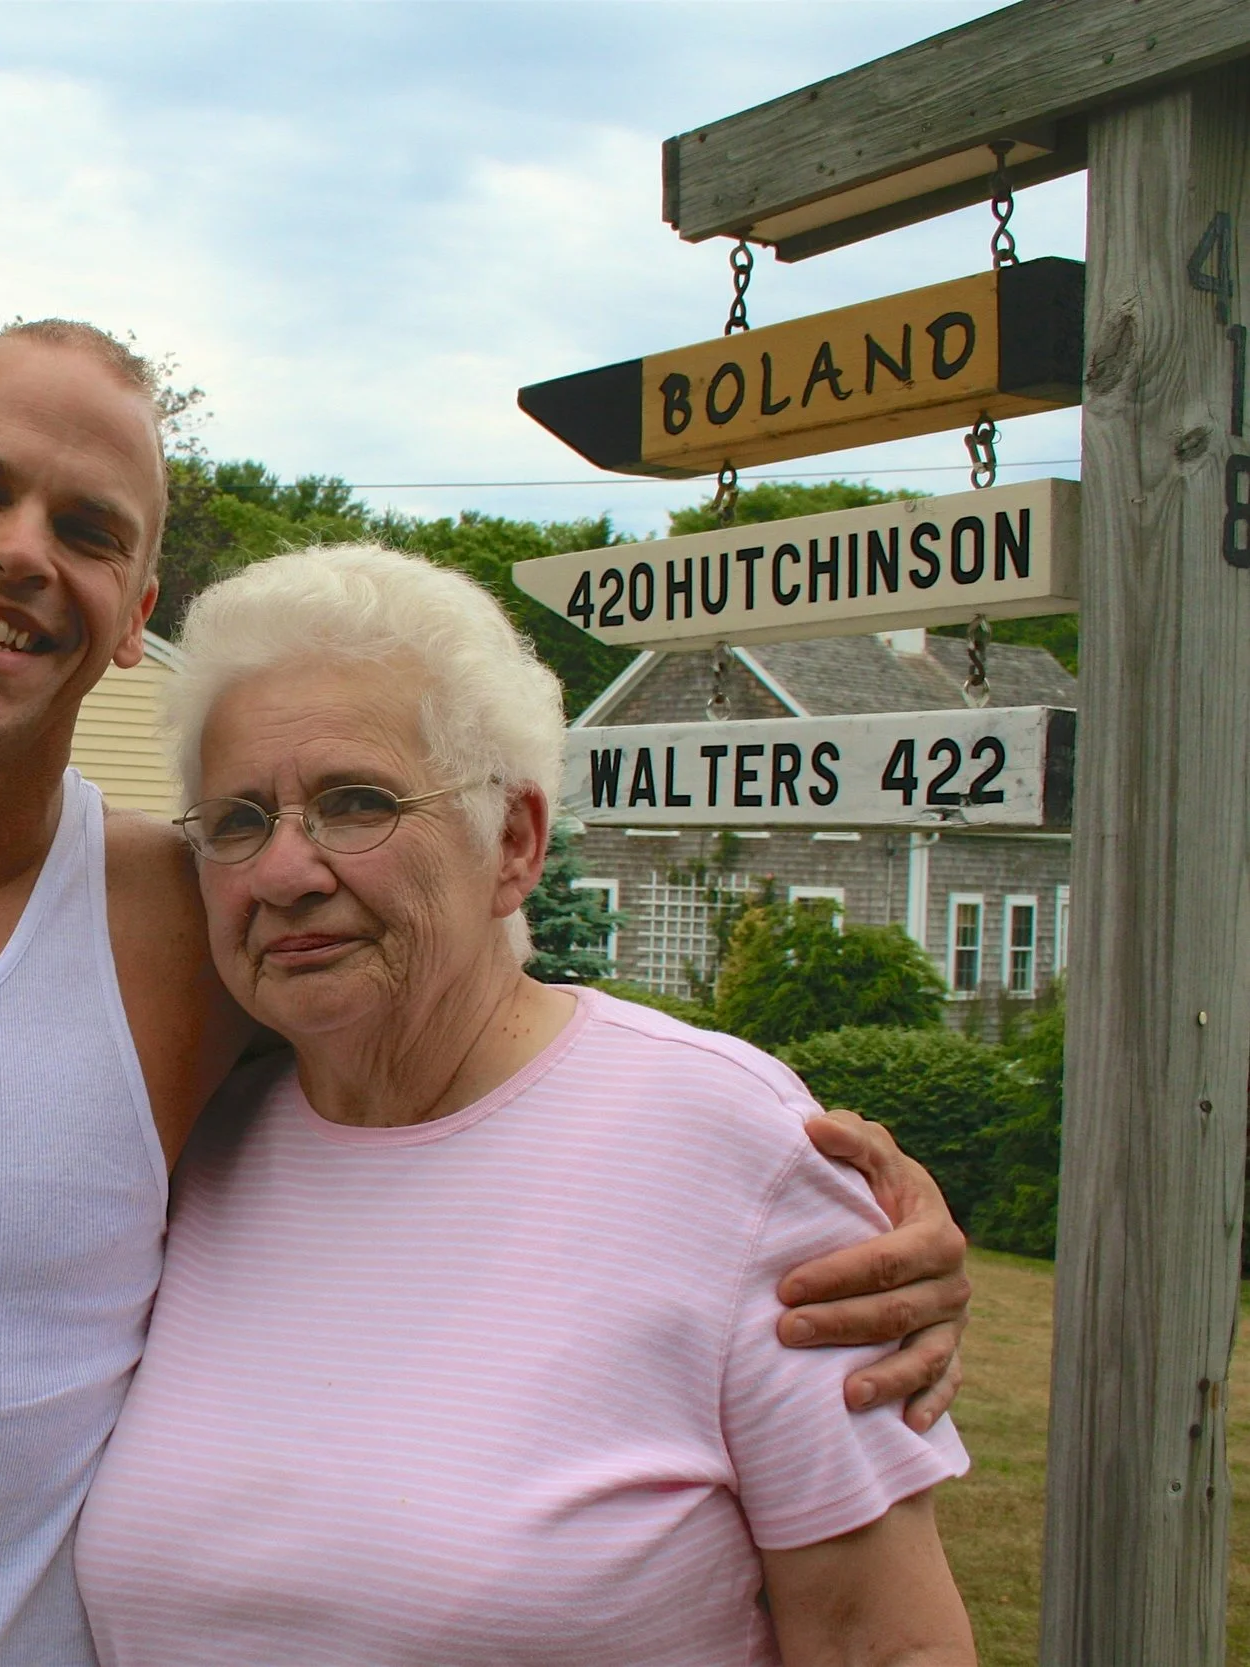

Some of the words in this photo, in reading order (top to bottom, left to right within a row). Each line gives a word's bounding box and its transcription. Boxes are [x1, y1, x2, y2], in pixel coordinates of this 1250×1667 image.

[658, 312, 976, 436] BOLAND
[566, 562, 655, 630] 420
[665, 508, 1031, 622] HUTCHINSON
[590, 741, 841, 808] WALTERS
[880, 735, 1007, 807] 422
